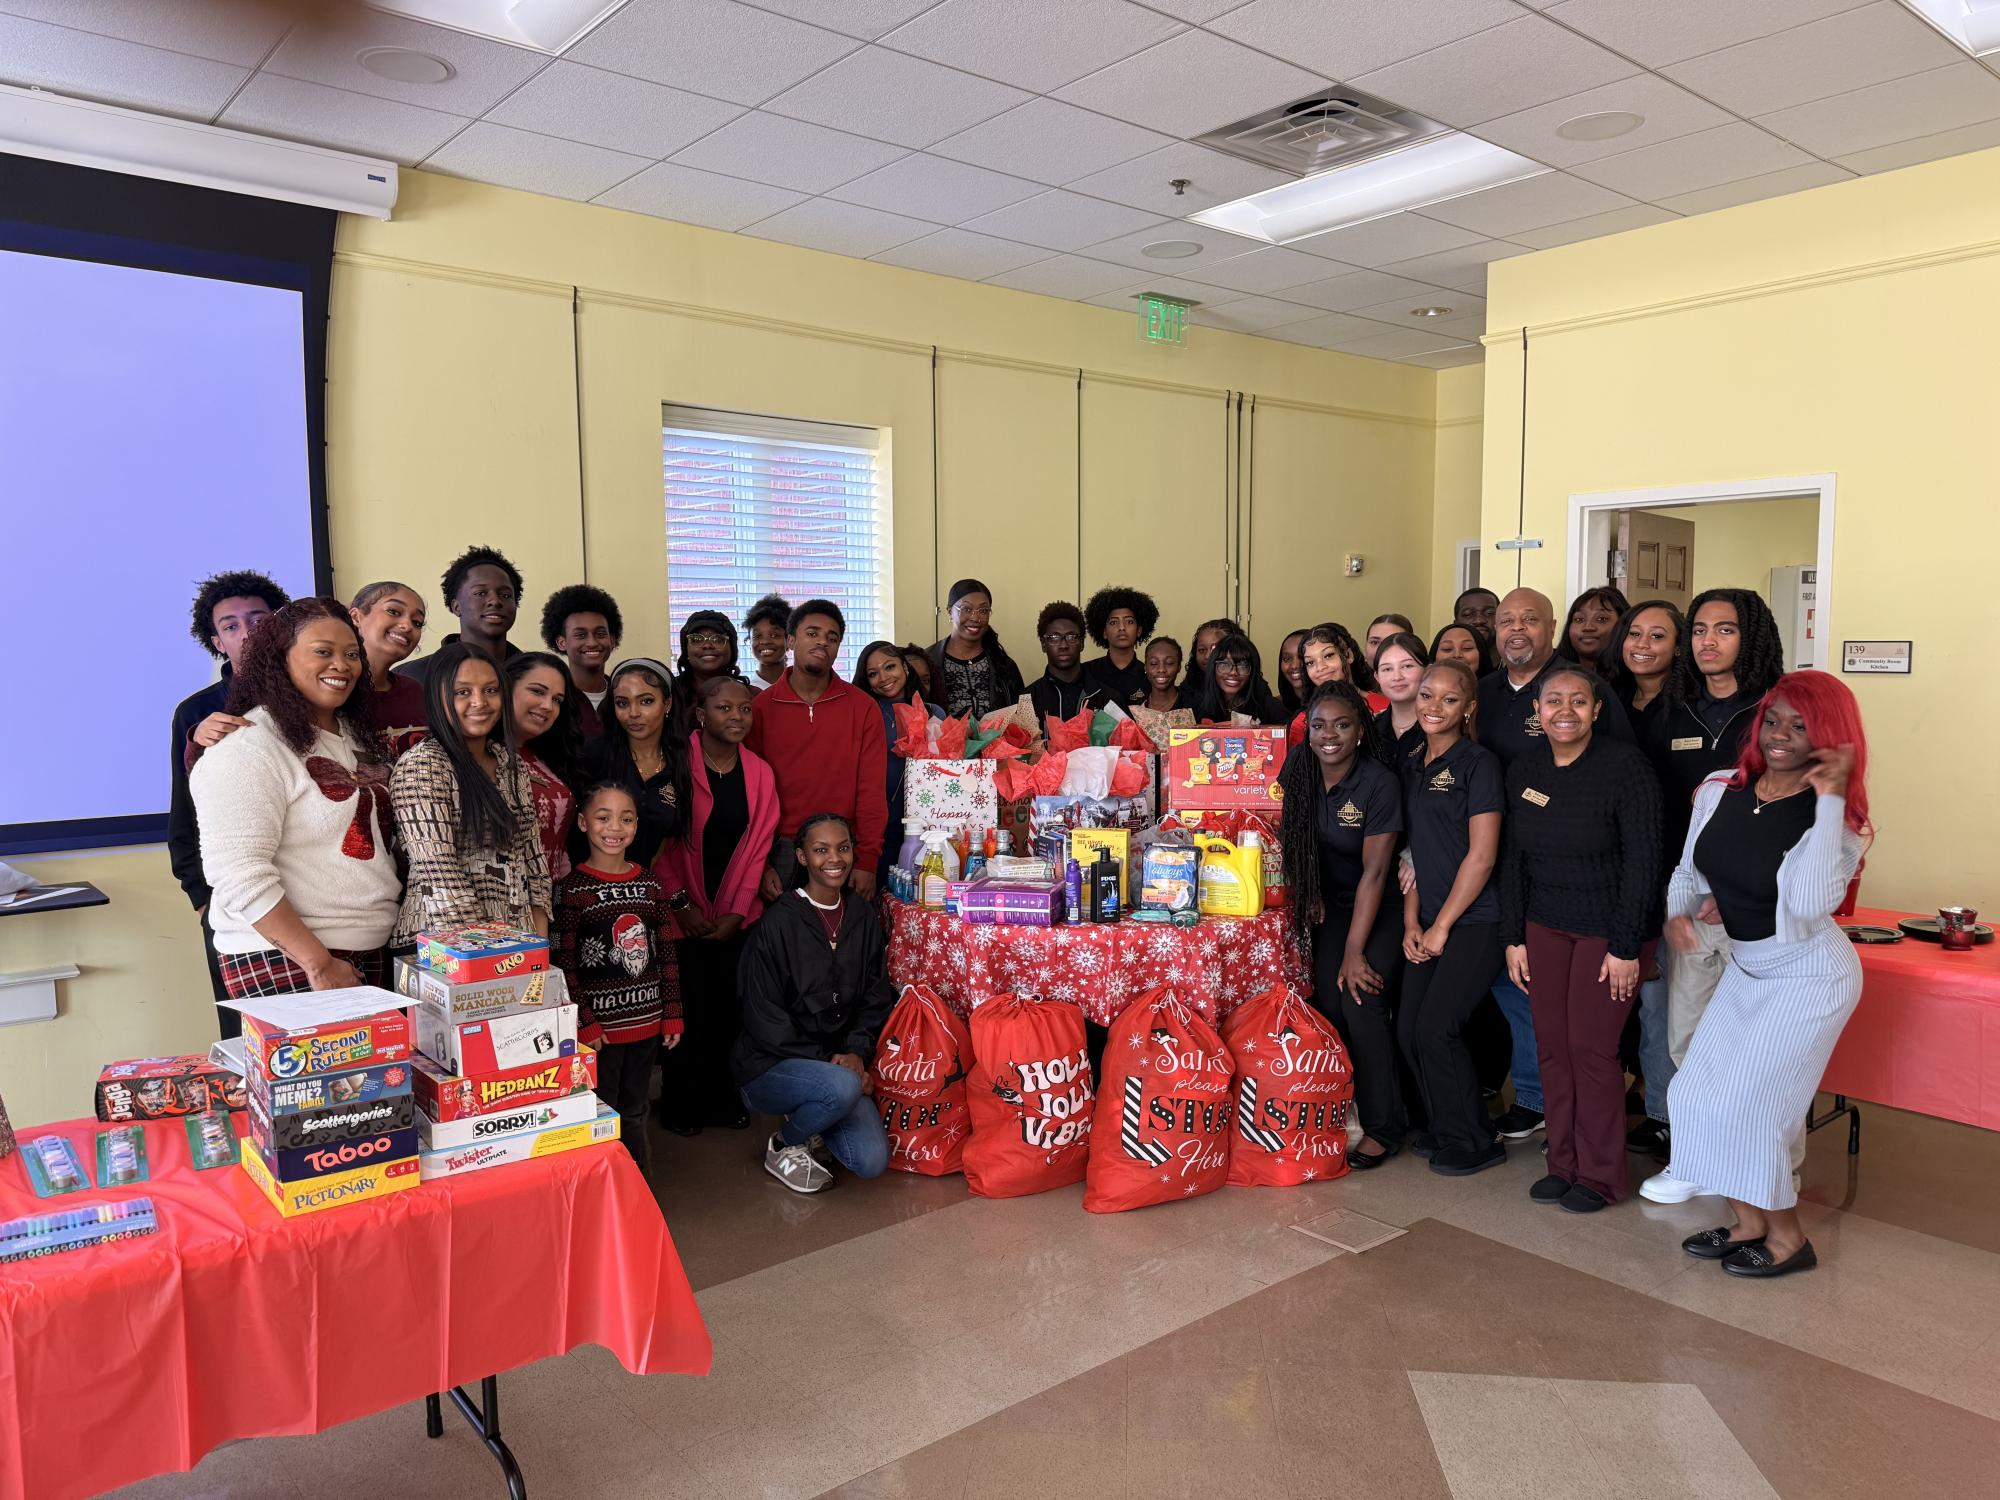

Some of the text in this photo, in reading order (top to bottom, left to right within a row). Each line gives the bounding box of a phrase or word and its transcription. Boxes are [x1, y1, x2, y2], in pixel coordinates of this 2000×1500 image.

[1147, 300, 1185, 343] EXIT
[1849, 645, 1865, 654] 139
[1233, 785, 1268, 796] variety
[930, 808, 973, 819] Happy
[1151, 866, 1184, 878] always
[597, 887, 646, 901] FELIZ
[493, 952, 526, 976] UNO
[452, 994, 519, 1014] MANCALA
[455, 990, 485, 1002] SOLID
[487, 985, 515, 997] WOOD
[593, 986, 660, 1010] NAVIDAD
[310, 1030, 368, 1057] SECOND
[276, 1047, 299, 1075] 5
[310, 1050, 347, 1072] RULE
[274, 1079, 323, 1093] WHAT DO YOU
[480, 1065, 561, 1104] HEDBANZ
[1173, 1075, 1228, 1094] please
[1288, 1074, 1340, 1096] please
[104, 1082, 134, 1122] Jenga
[275, 1087, 322, 1108] MEME?
[298, 1096, 326, 1110] FAMILY
[302, 1106, 393, 1135] Scattergories
[474, 1112, 536, 1138] SORRY!
[304, 1137, 392, 1172] Taboo
[445, 1145, 493, 1172] Twister
[476, 1149, 508, 1166] ULTIMATE
[887, 1133, 943, 1161] Here
[1177, 1139, 1226, 1178] Here
[1290, 1132, 1344, 1162] Here
[779, 1158, 798, 1176] N
[294, 1177, 378, 1210] PICTIONARY
